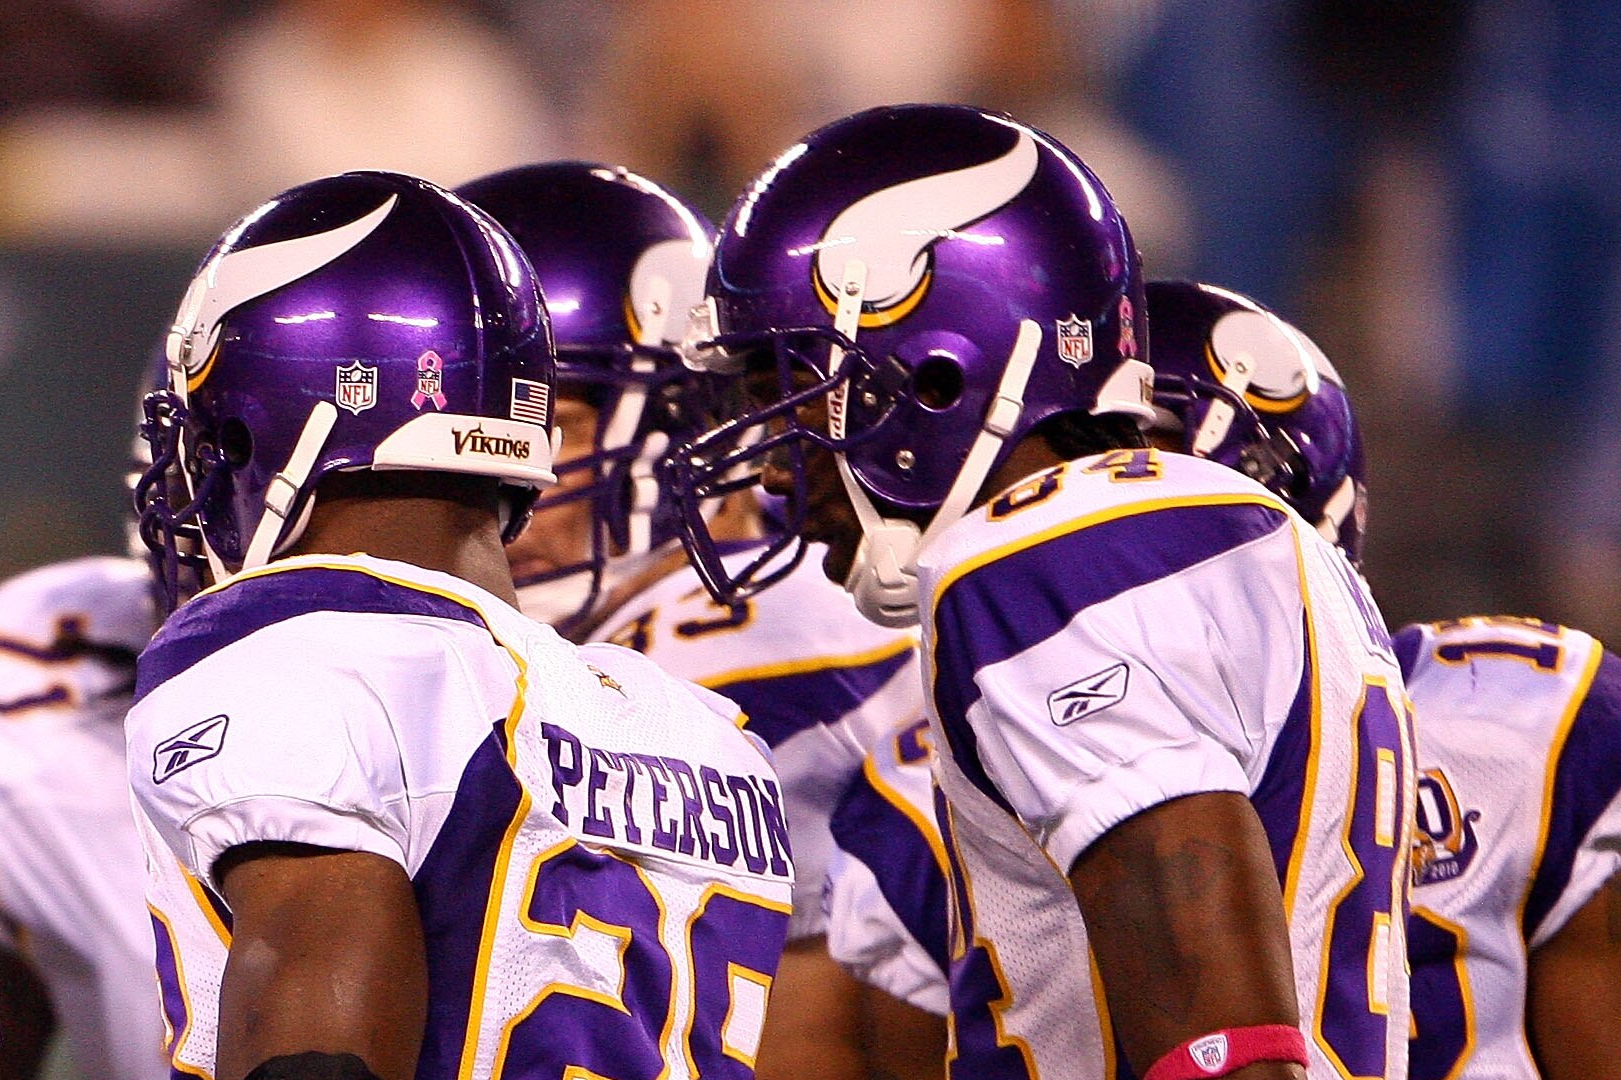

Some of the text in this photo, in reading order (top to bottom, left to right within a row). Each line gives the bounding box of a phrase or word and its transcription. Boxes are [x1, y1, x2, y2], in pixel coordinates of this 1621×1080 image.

[1063, 339, 1087, 358] NFL
[341, 384, 371, 406] NFL
[420, 380, 439, 395] NFL
[541, 721, 797, 878] PETERSON
